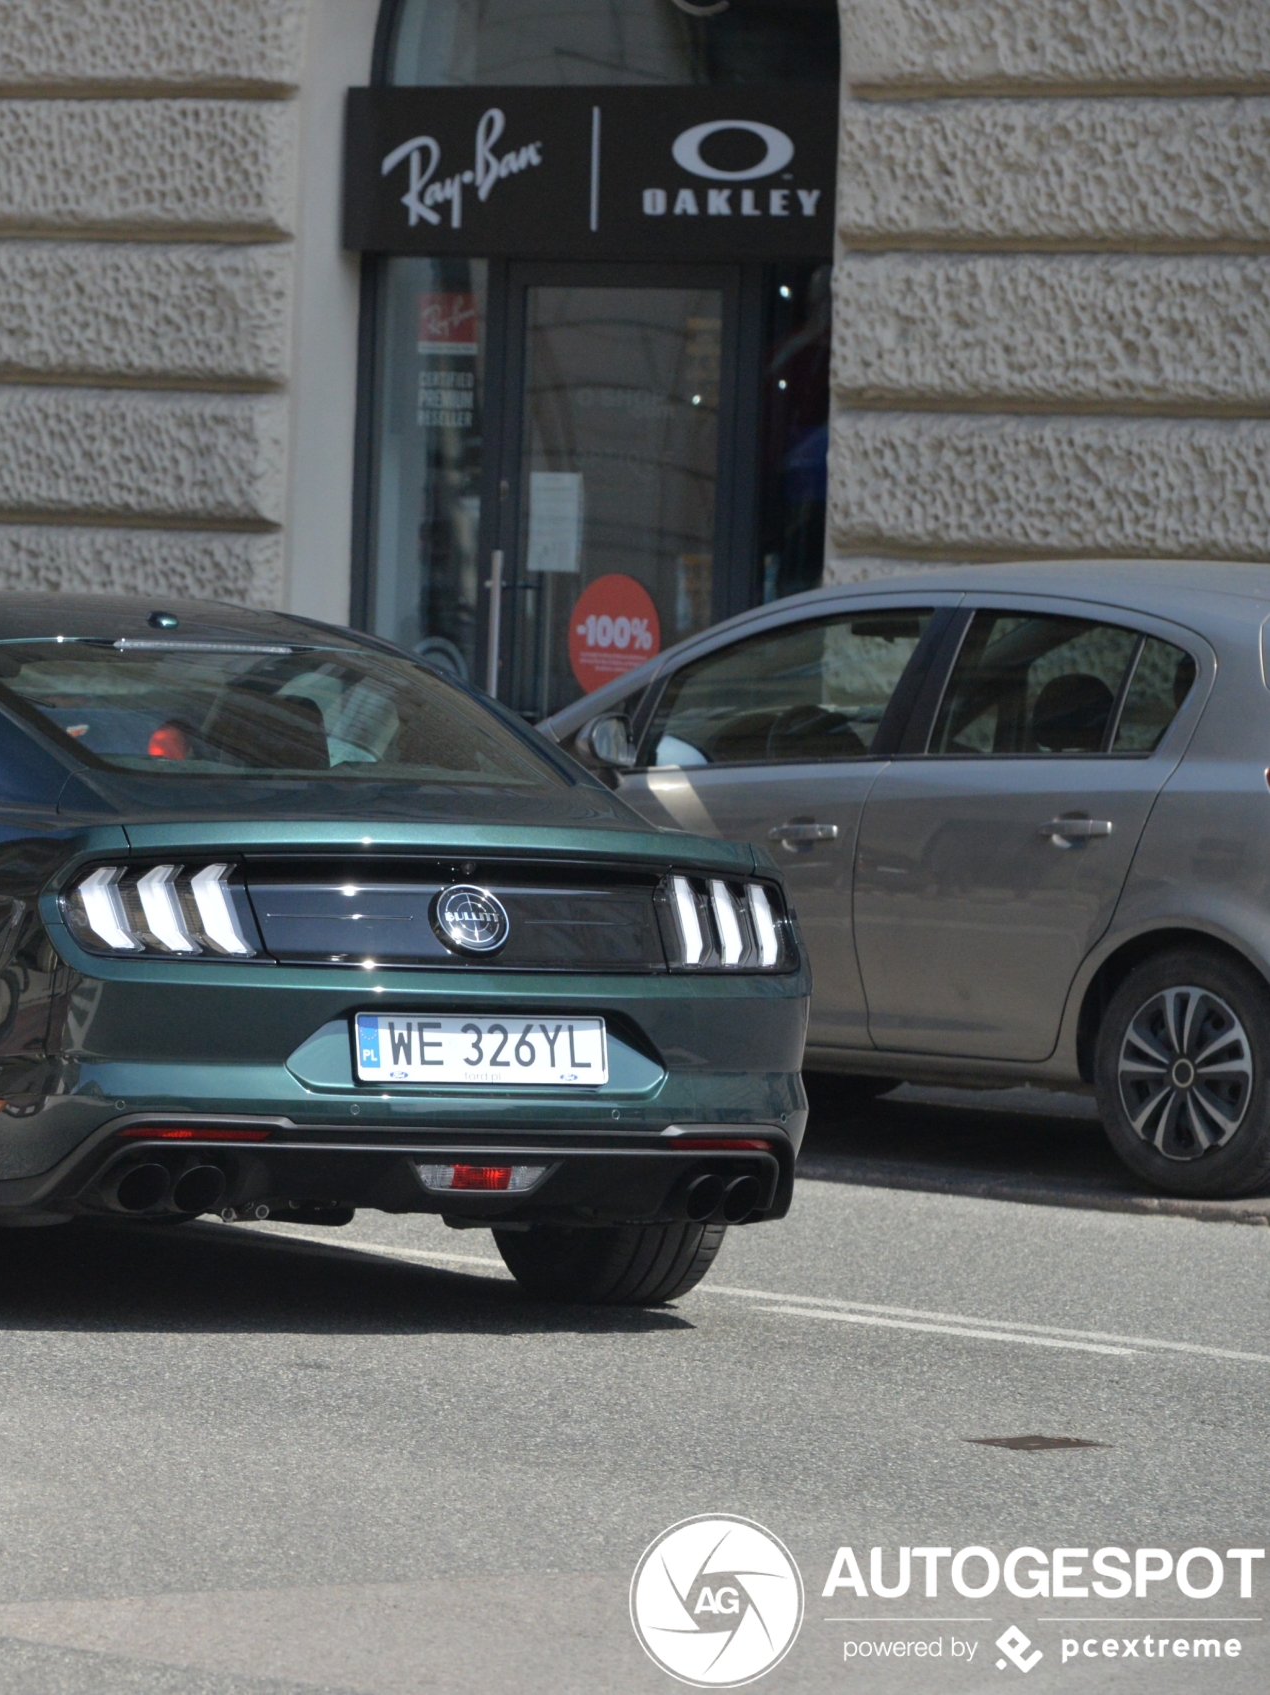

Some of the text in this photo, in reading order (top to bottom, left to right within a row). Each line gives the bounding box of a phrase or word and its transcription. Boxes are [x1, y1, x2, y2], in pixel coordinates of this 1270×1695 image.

[642, 188, 822, 217] OAKLEY
[576, 614, 653, 651] -100%
[444, 911, 500, 923] BULLITT
[362, 1048, 378, 1062] PL
[388, 1021, 592, 1068] WE 326YL
